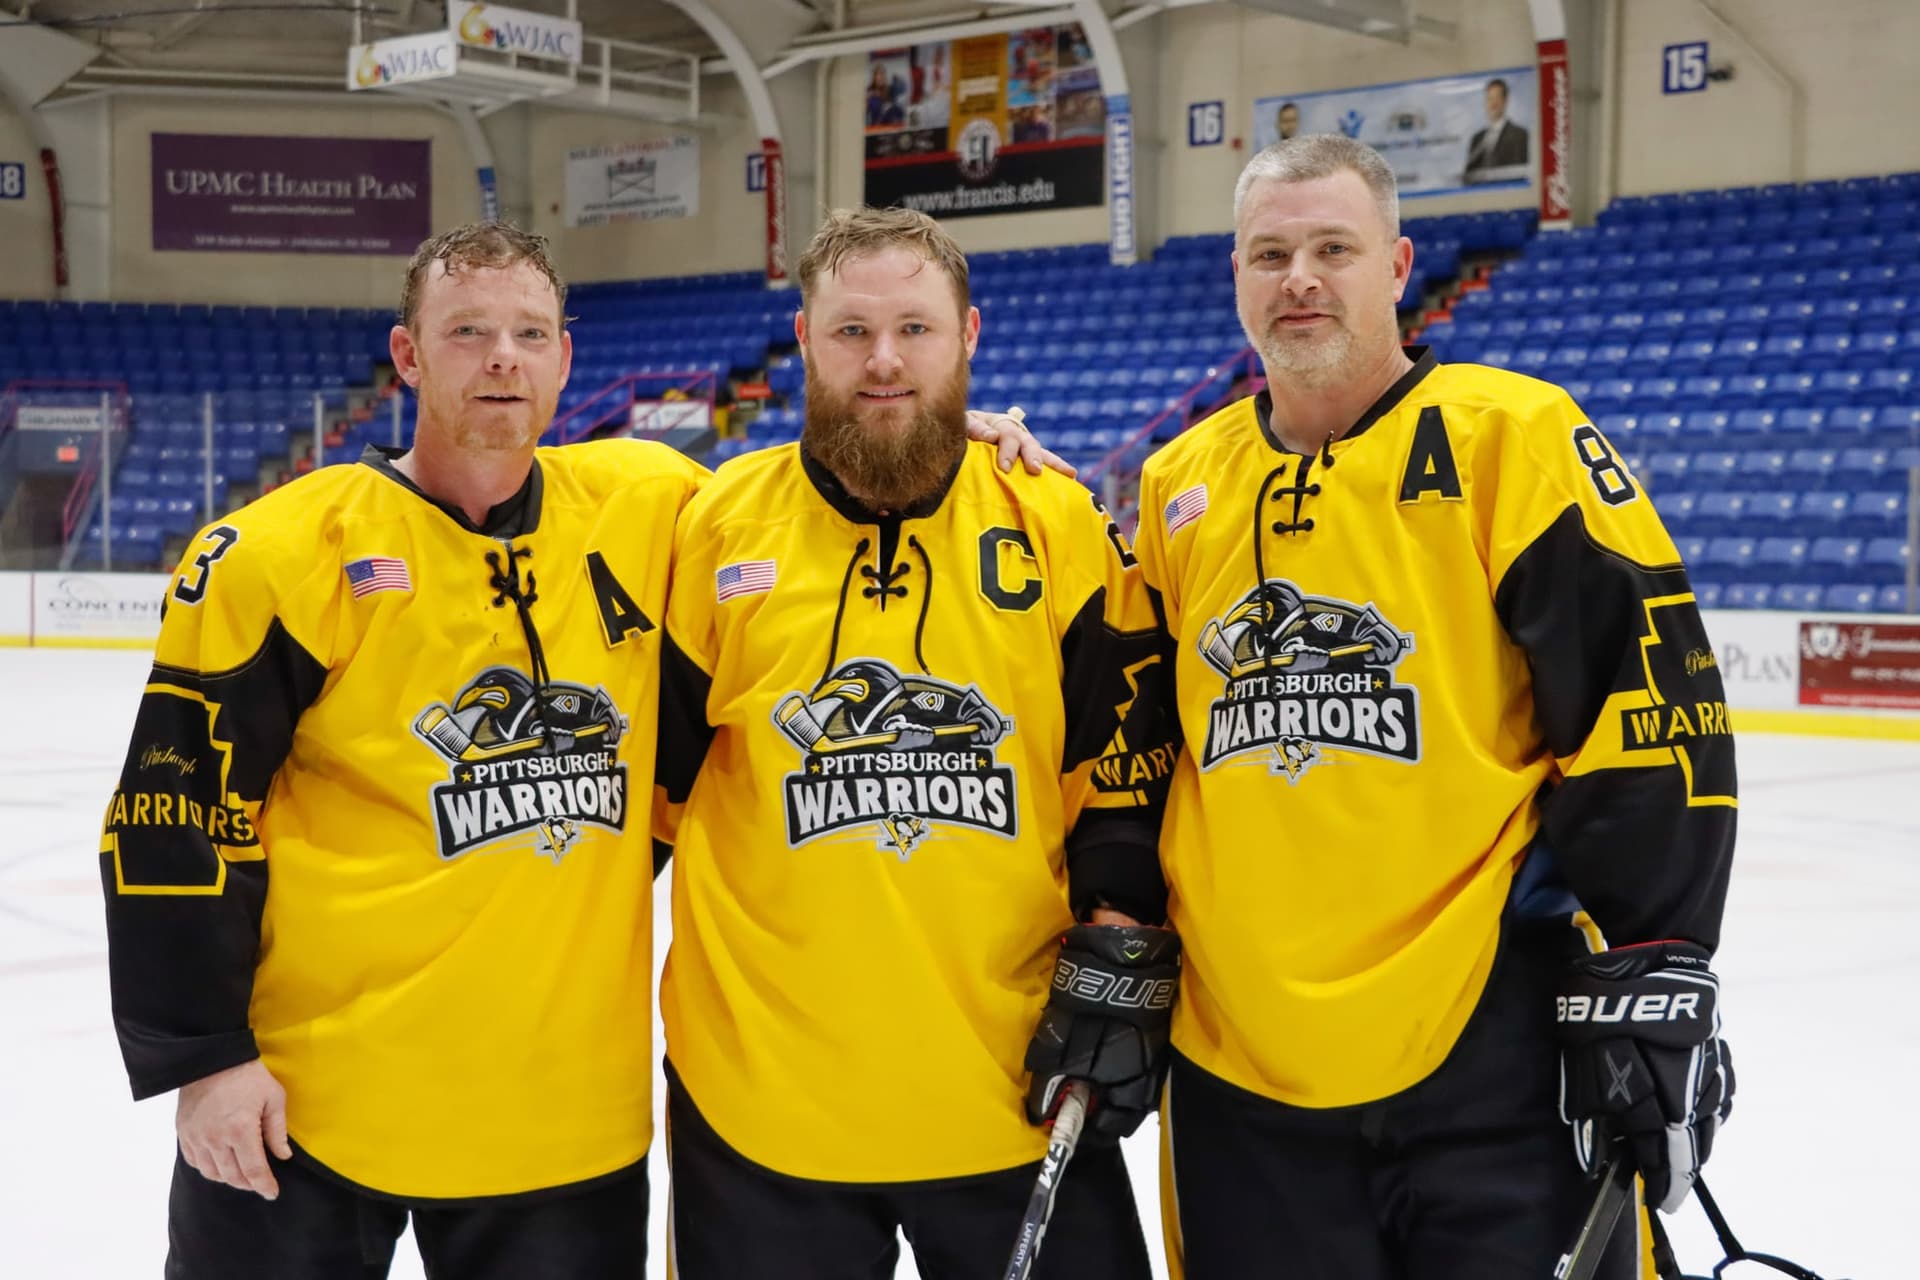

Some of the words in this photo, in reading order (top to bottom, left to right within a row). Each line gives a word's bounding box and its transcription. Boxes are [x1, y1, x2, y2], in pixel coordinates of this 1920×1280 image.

[388, 45, 448, 75] WJAC
[503, 22, 574, 57] WJAC
[1667, 47, 1704, 90] 15
[1192, 104, 1220, 143] 16
[0, 164, 21, 196] 8
[1111, 119, 1131, 194] LIGHT
[165, 169, 255, 196] UPMC
[903, 178, 1055, 211] www.francis.edu
[1112, 197, 1132, 251] BUD
[1401, 405, 1464, 502] A
[1573, 423, 1638, 507] 8
[174, 525, 240, 606] 3
[979, 527, 1042, 611] C
[584, 549, 657, 647] A
[1233, 673, 1372, 701] PITTSBURGH
[1210, 698, 1408, 760] WARRIORS
[472, 752, 609, 784] PITTSBURGH
[821, 752, 978, 776] PITTSBURGH
[440, 775, 624, 846] WARRIORS
[791, 775, 1008, 837] WARRIORS
